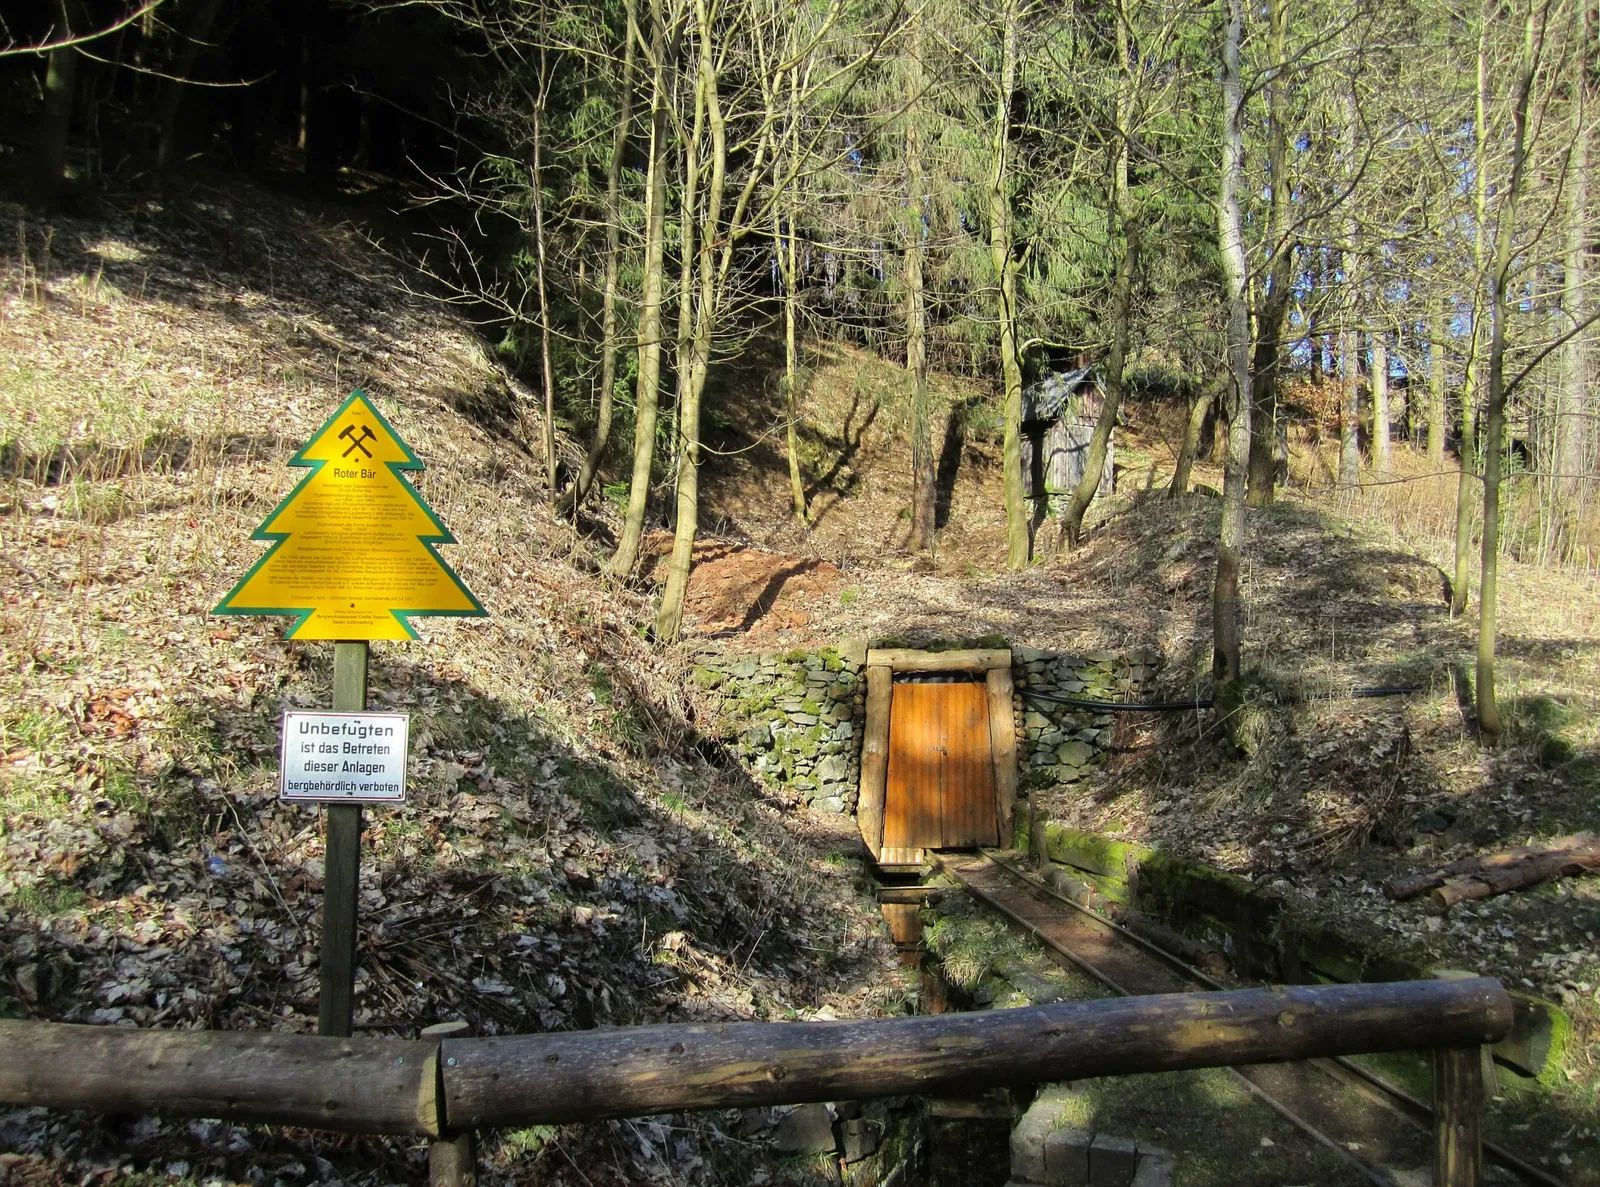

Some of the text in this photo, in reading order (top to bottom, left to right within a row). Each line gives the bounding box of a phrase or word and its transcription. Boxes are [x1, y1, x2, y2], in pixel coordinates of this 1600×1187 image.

[333, 468, 377, 479] Roter Bär
[299, 721, 394, 739] Unbefugten
[300, 742, 390, 755] ist das Betreten
[304, 760, 385, 776] dieser Anlagen
[288, 780, 399, 792] bergbehördlich verboten
